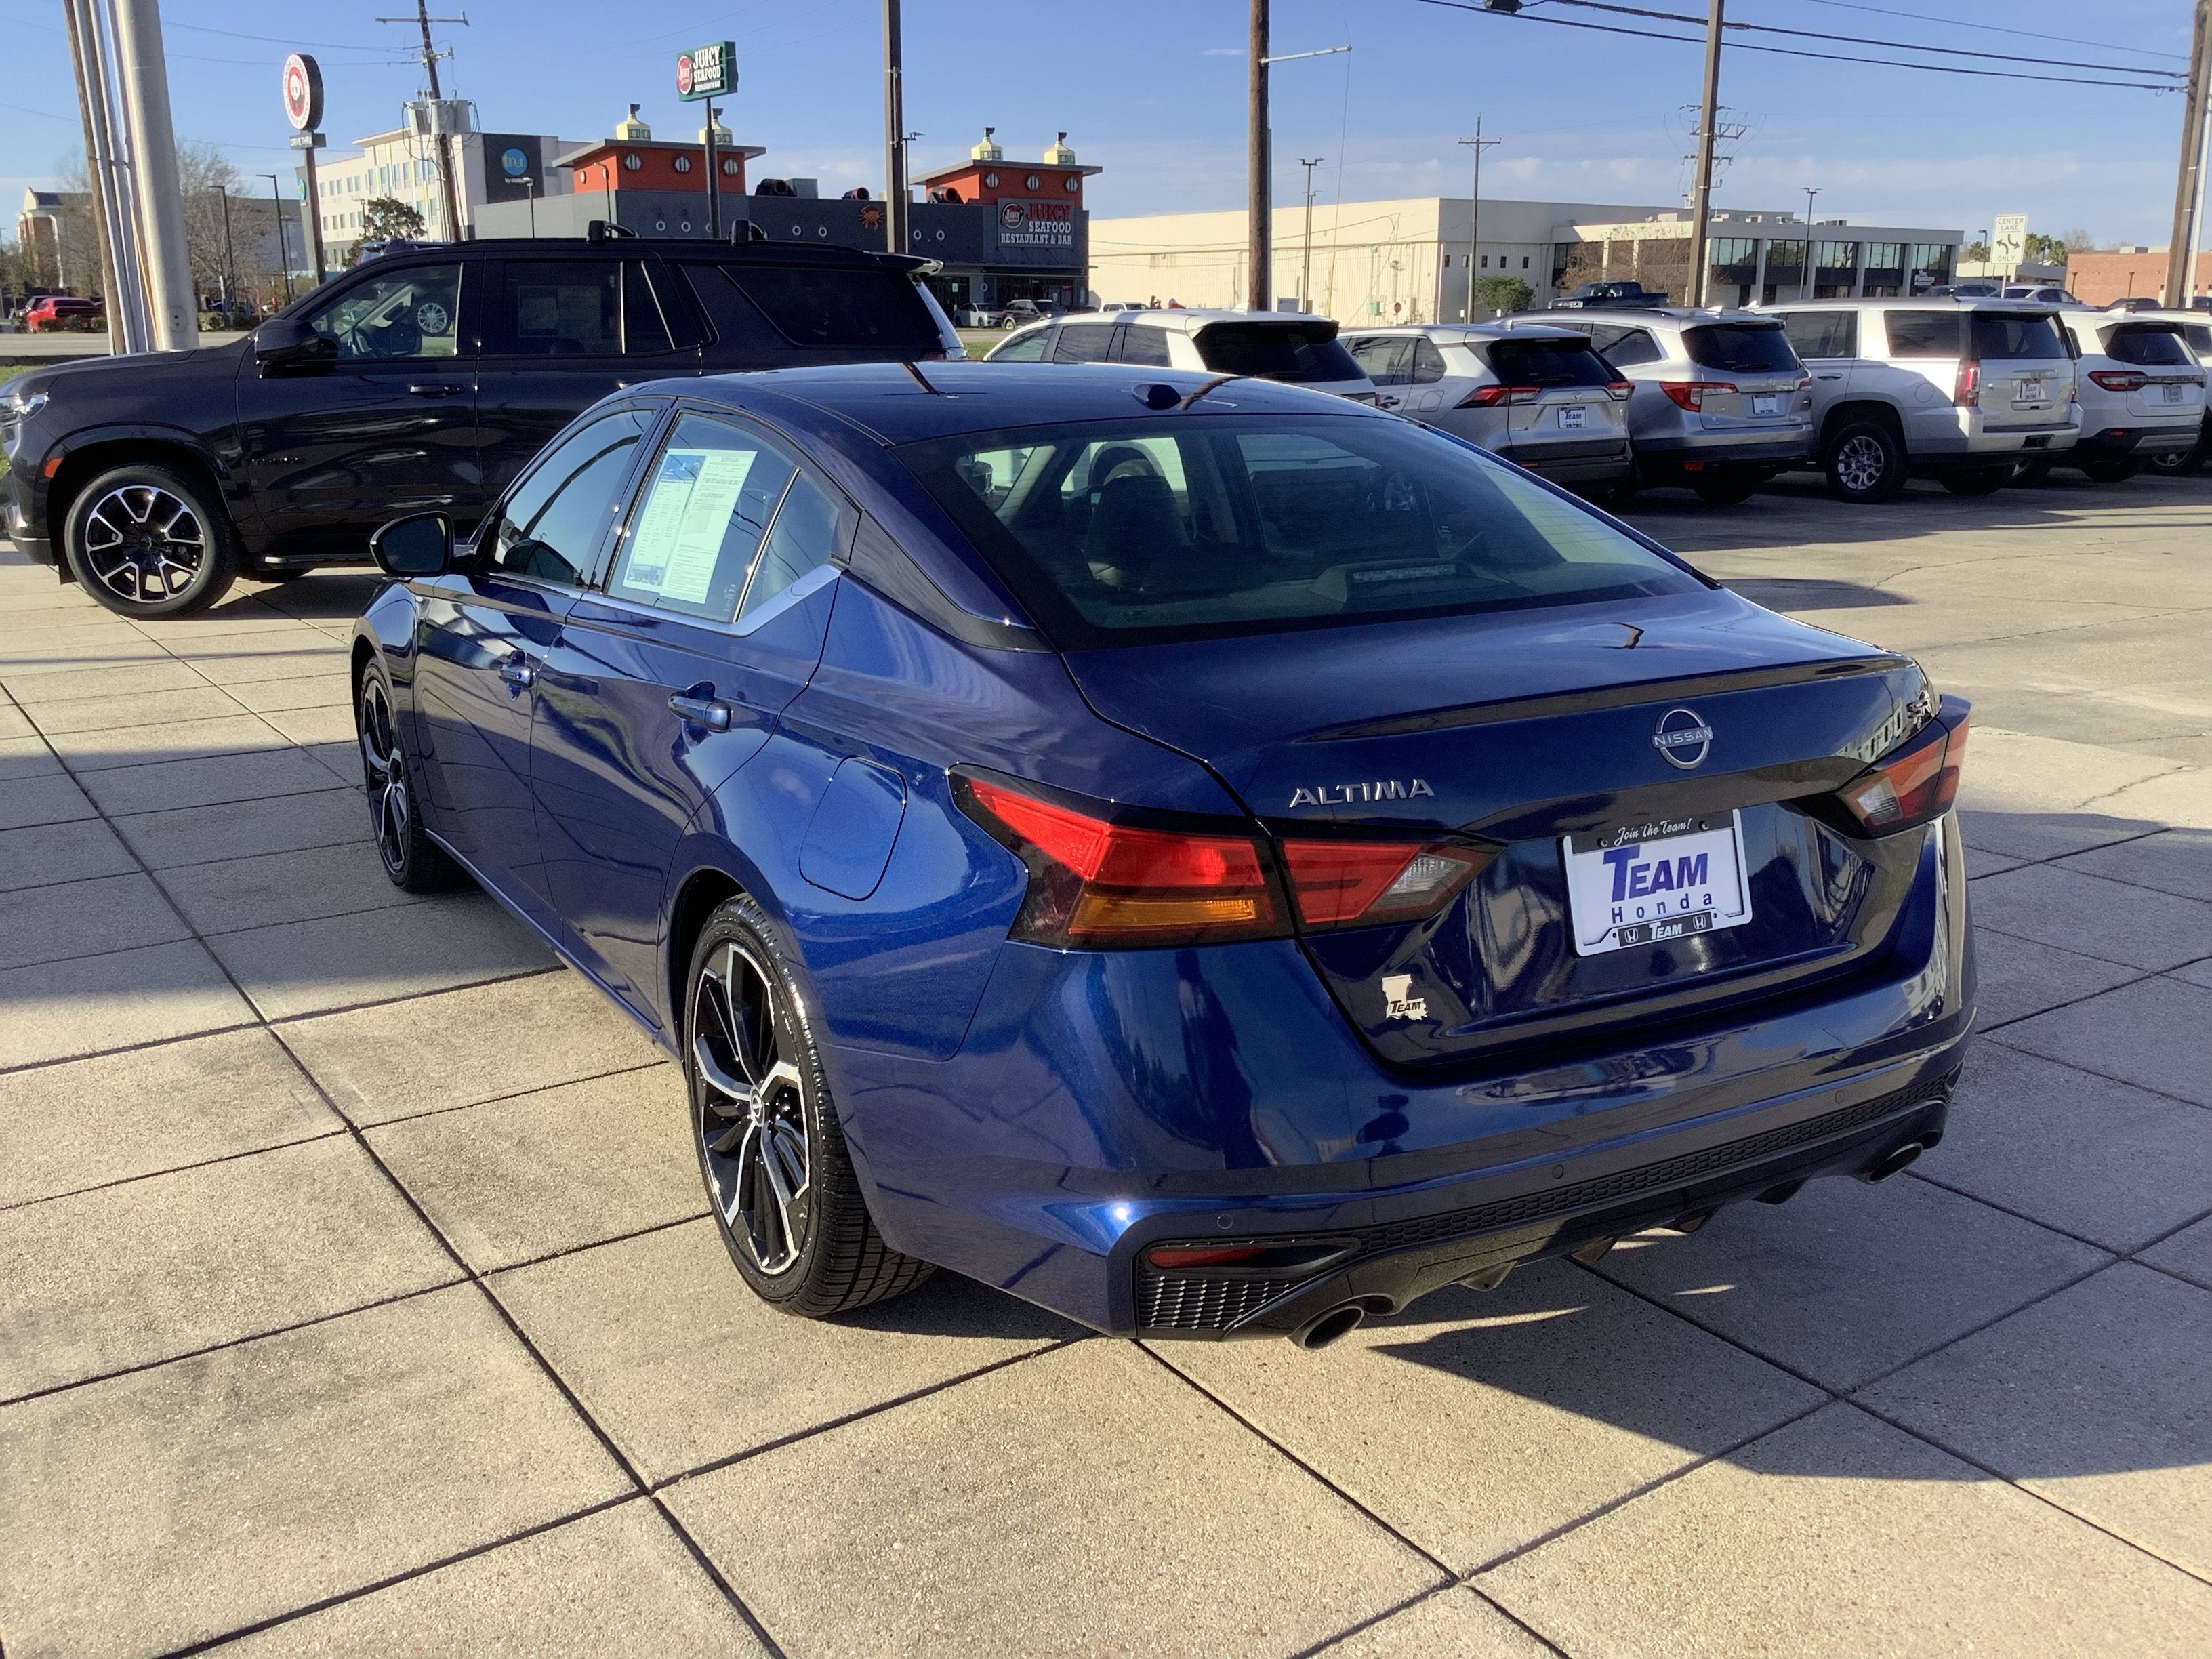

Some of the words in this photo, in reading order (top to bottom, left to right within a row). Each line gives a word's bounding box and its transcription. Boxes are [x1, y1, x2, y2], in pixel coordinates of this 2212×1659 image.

[693, 46, 720, 70] JUICY
[694, 65, 721, 83] SEAFOOD
[1027, 204, 1070, 221] JUICY
[1029, 221, 1071, 233] SEAFOOD
[1001, 233, 1048, 244] RESTAURANT
[1050, 234, 1056, 244] &
[1058, 235, 1072, 245] BAR
[1654, 729, 1713, 746] NISSAN
[1289, 779, 1435, 808] ALTIMA
[1614, 827, 1639, 846] Join
[1660, 817, 1692, 834] Team!
[1603, 844, 1708, 903] TEAM
[1611, 893, 1713, 924] Honda
[1649, 922, 1683, 941] TEAM
[1391, 1000, 1422, 1014] TEAM
